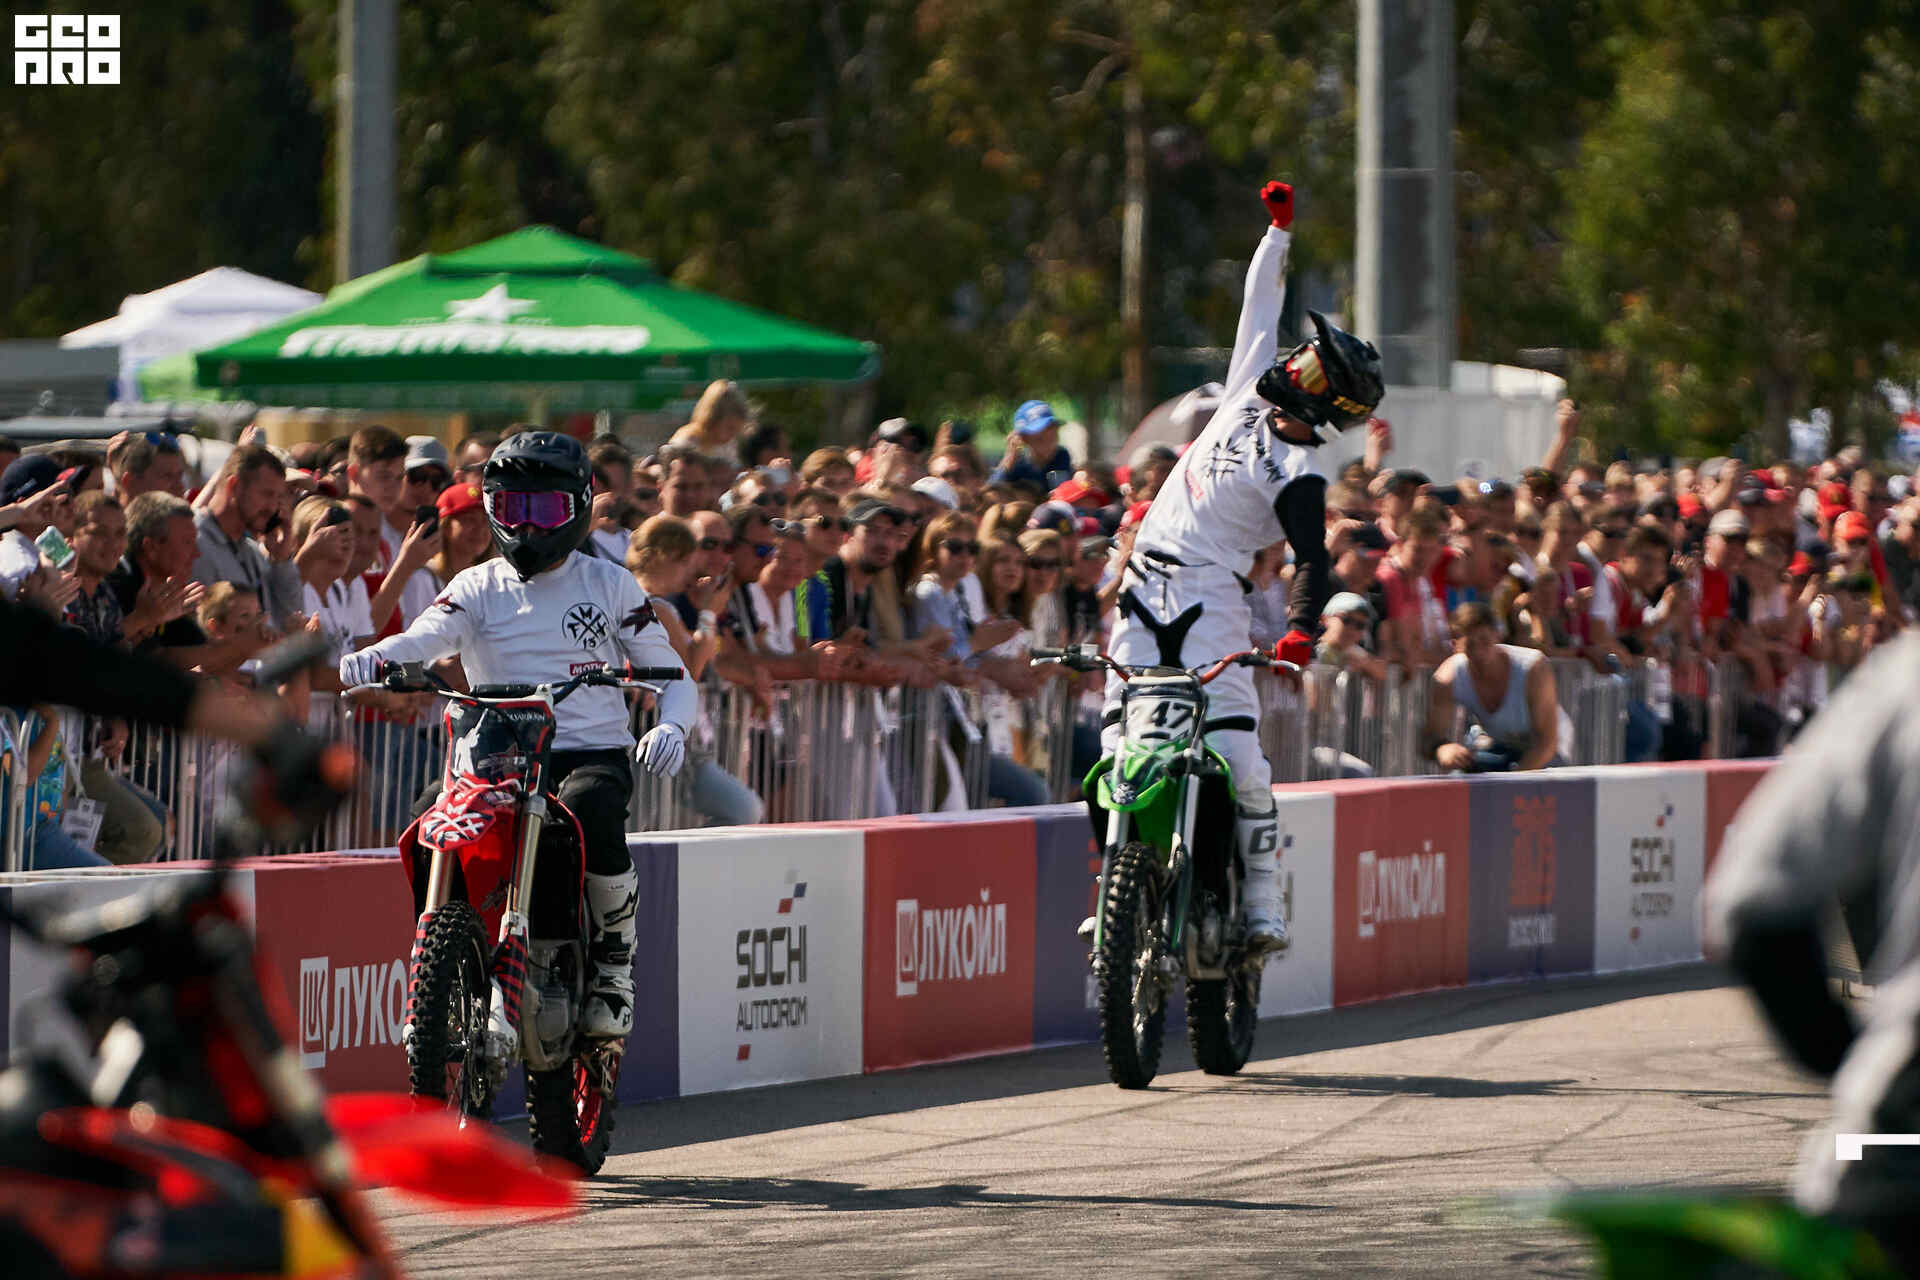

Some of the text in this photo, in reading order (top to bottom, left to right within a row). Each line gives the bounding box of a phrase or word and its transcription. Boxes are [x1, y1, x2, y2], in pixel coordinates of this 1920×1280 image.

[736, 925, 807, 989] SOCHI
[919, 887, 1007, 982] ЛУКОЙЛ
[329, 958, 408, 1052] ЛУКО
[736, 996, 808, 1032] AUTODROM
